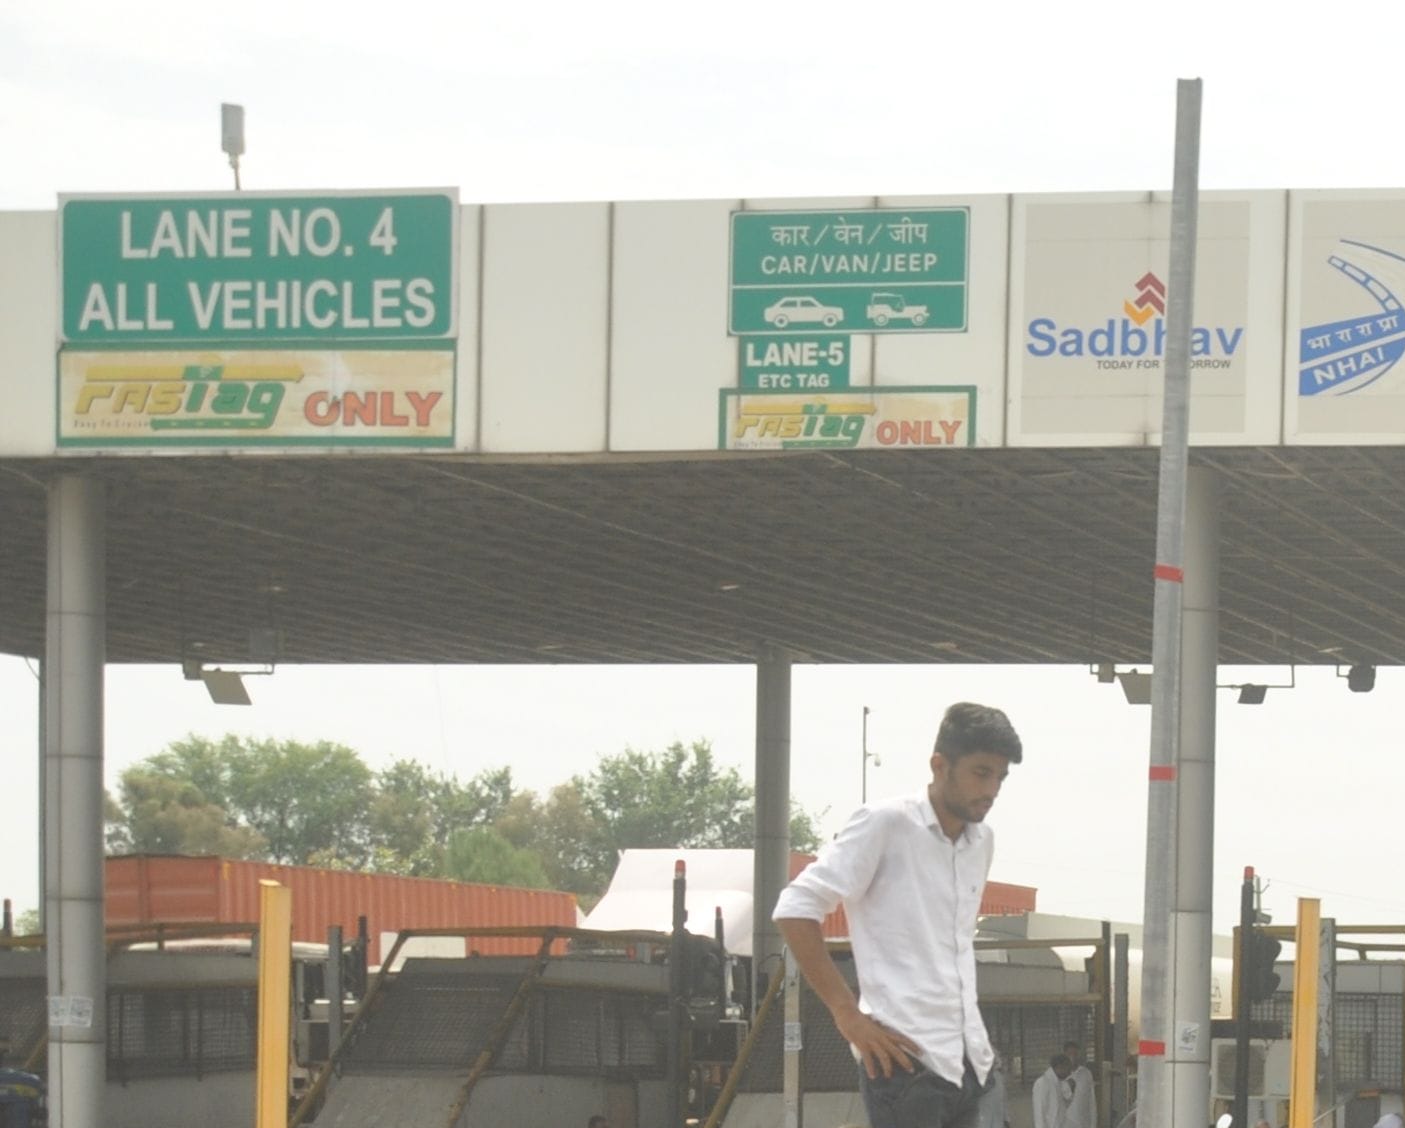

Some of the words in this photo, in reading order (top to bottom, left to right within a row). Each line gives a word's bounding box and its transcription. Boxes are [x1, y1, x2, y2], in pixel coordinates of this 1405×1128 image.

[120, 209, 252, 259] LANE
[269, 208, 354, 257] NO.
[370, 207, 398, 255] 4
[770, 223, 811, 246] कार
[887, 216, 929, 244] जीप
[760, 252, 938, 276] CAR/VAN/JEEP
[78, 282, 174, 333] ALL
[188, 278, 436, 330] VEHICLES
[745, 340, 845, 367] LANE-5
[1307, 333, 1332, 353] भा
[1096, 360, 1134, 370] TODAY
[1137, 360, 1161, 370] FOR
[1163, 359, 1232, 370] ORROW
[1312, 345, 1387, 386] NHAI
[758, 374, 792, 388] ETC
[797, 373, 830, 387] TAG
[303, 390, 444, 428] ONLY
[875, 420, 963, 446] ONLY
